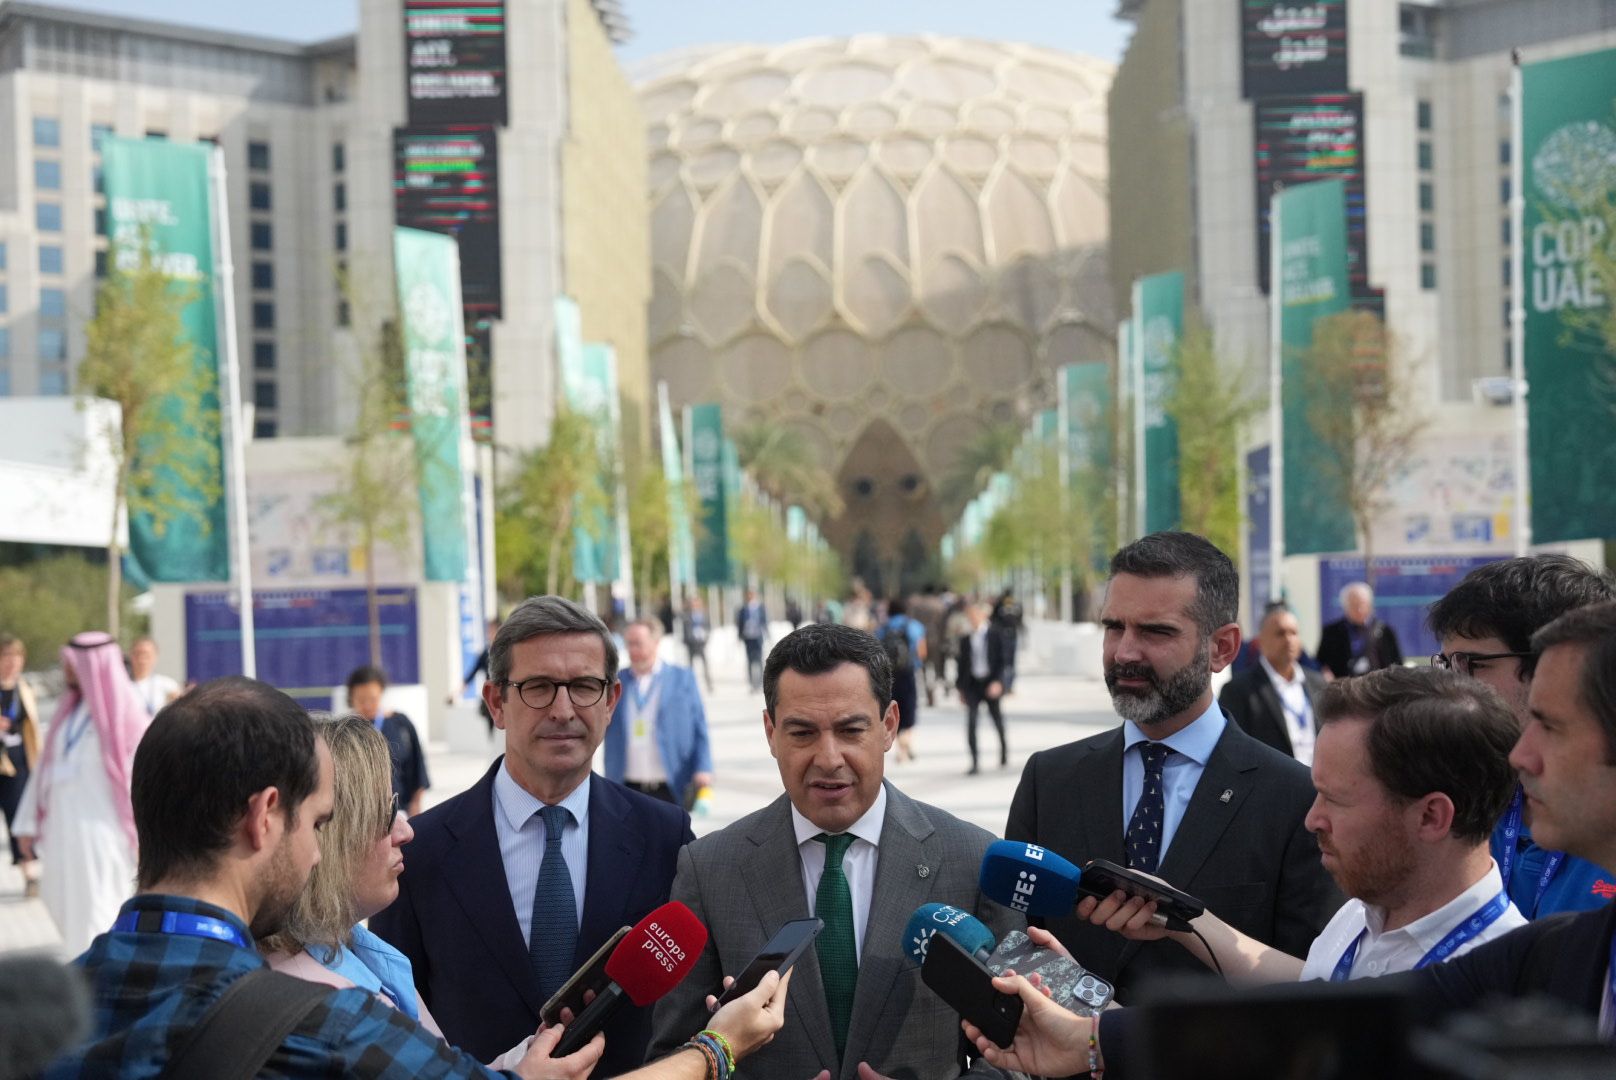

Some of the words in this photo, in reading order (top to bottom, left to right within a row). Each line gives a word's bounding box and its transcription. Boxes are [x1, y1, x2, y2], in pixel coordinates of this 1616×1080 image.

[1533, 217, 1615, 266] COP
[1533, 262, 1604, 312] UAE
[641, 939, 675, 972] press
[649, 922, 686, 961] europa
